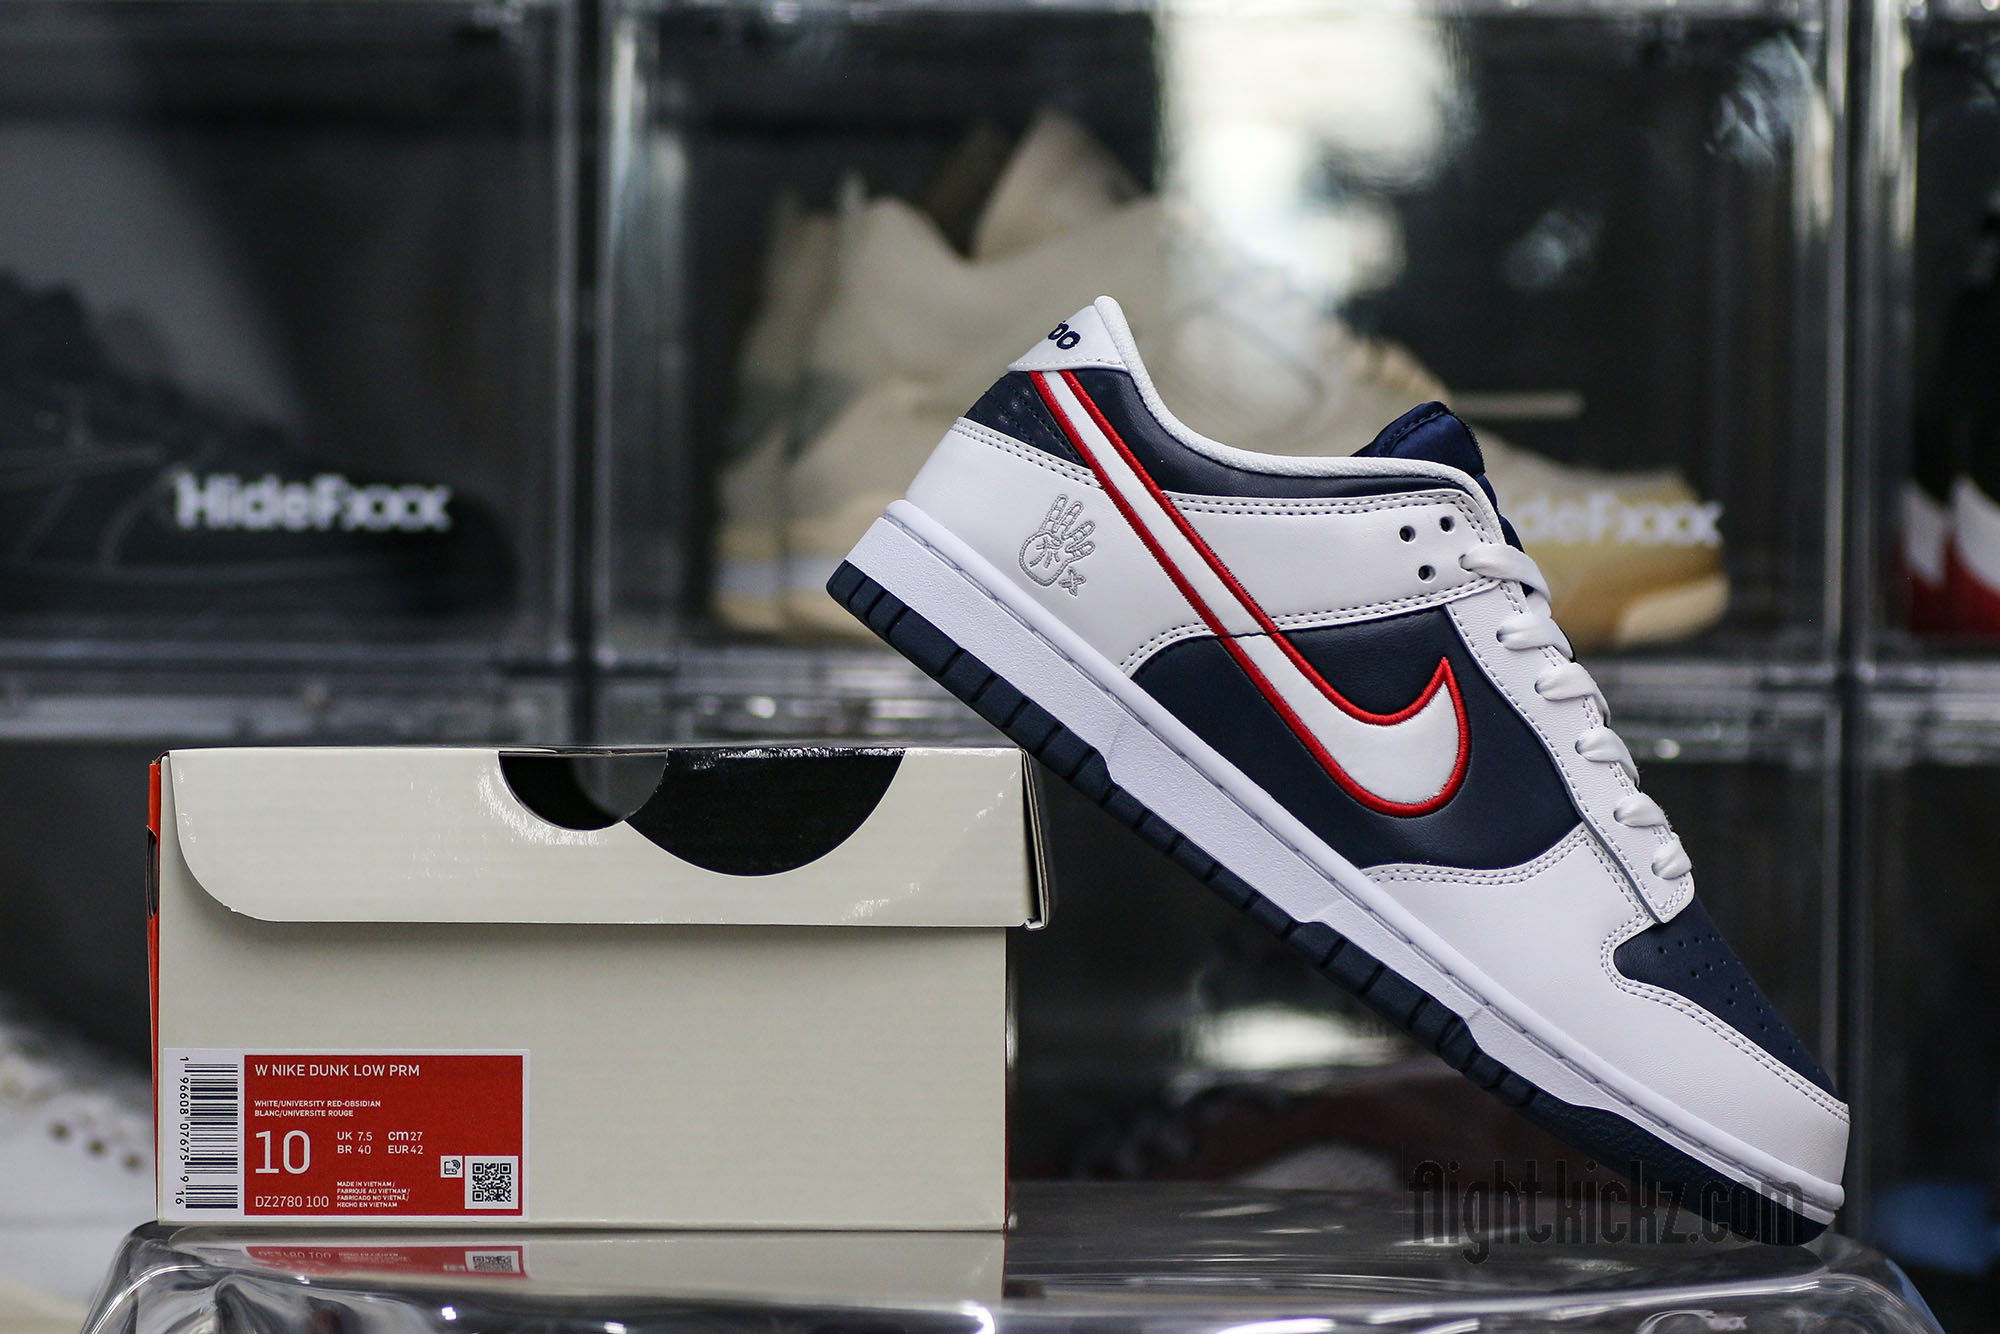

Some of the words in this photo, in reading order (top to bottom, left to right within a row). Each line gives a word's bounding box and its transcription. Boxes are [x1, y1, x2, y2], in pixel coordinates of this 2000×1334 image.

[254, 1064, 268, 1077] W
[272, 1064, 305, 1077] NIKE
[310, 1064, 350, 1077] DUNK
[353, 1064, 386, 1077] LOW
[389, 1064, 420, 1077] PRM
[180, 1077, 189, 1115] 96608
[254, 1100, 325, 1108] WHITE/UNIVERSITY
[327, 1100, 381, 1108] RED-OBSIDIAN
[254, 1110, 326, 1118] BLANC/UNIVERSITE
[328, 1110, 354, 1118] ROUGE
[180, 1123, 189, 1161] 07675
[336, 1131, 353, 1141] UK
[357, 1131, 373, 1142] 7.5
[410, 1131, 423, 1142] 27
[255, 1130, 311, 1175] 10
[336, 1145, 352, 1154] BR
[357, 1145, 372, 1155] 40
[387, 1145, 409, 1154] EUR
[410, 1145, 424, 1155] 42
[175, 1190, 185, 1205] 16
[255, 1196, 303, 1208] DZ2780
[306, 1196, 330, 1208] 100
